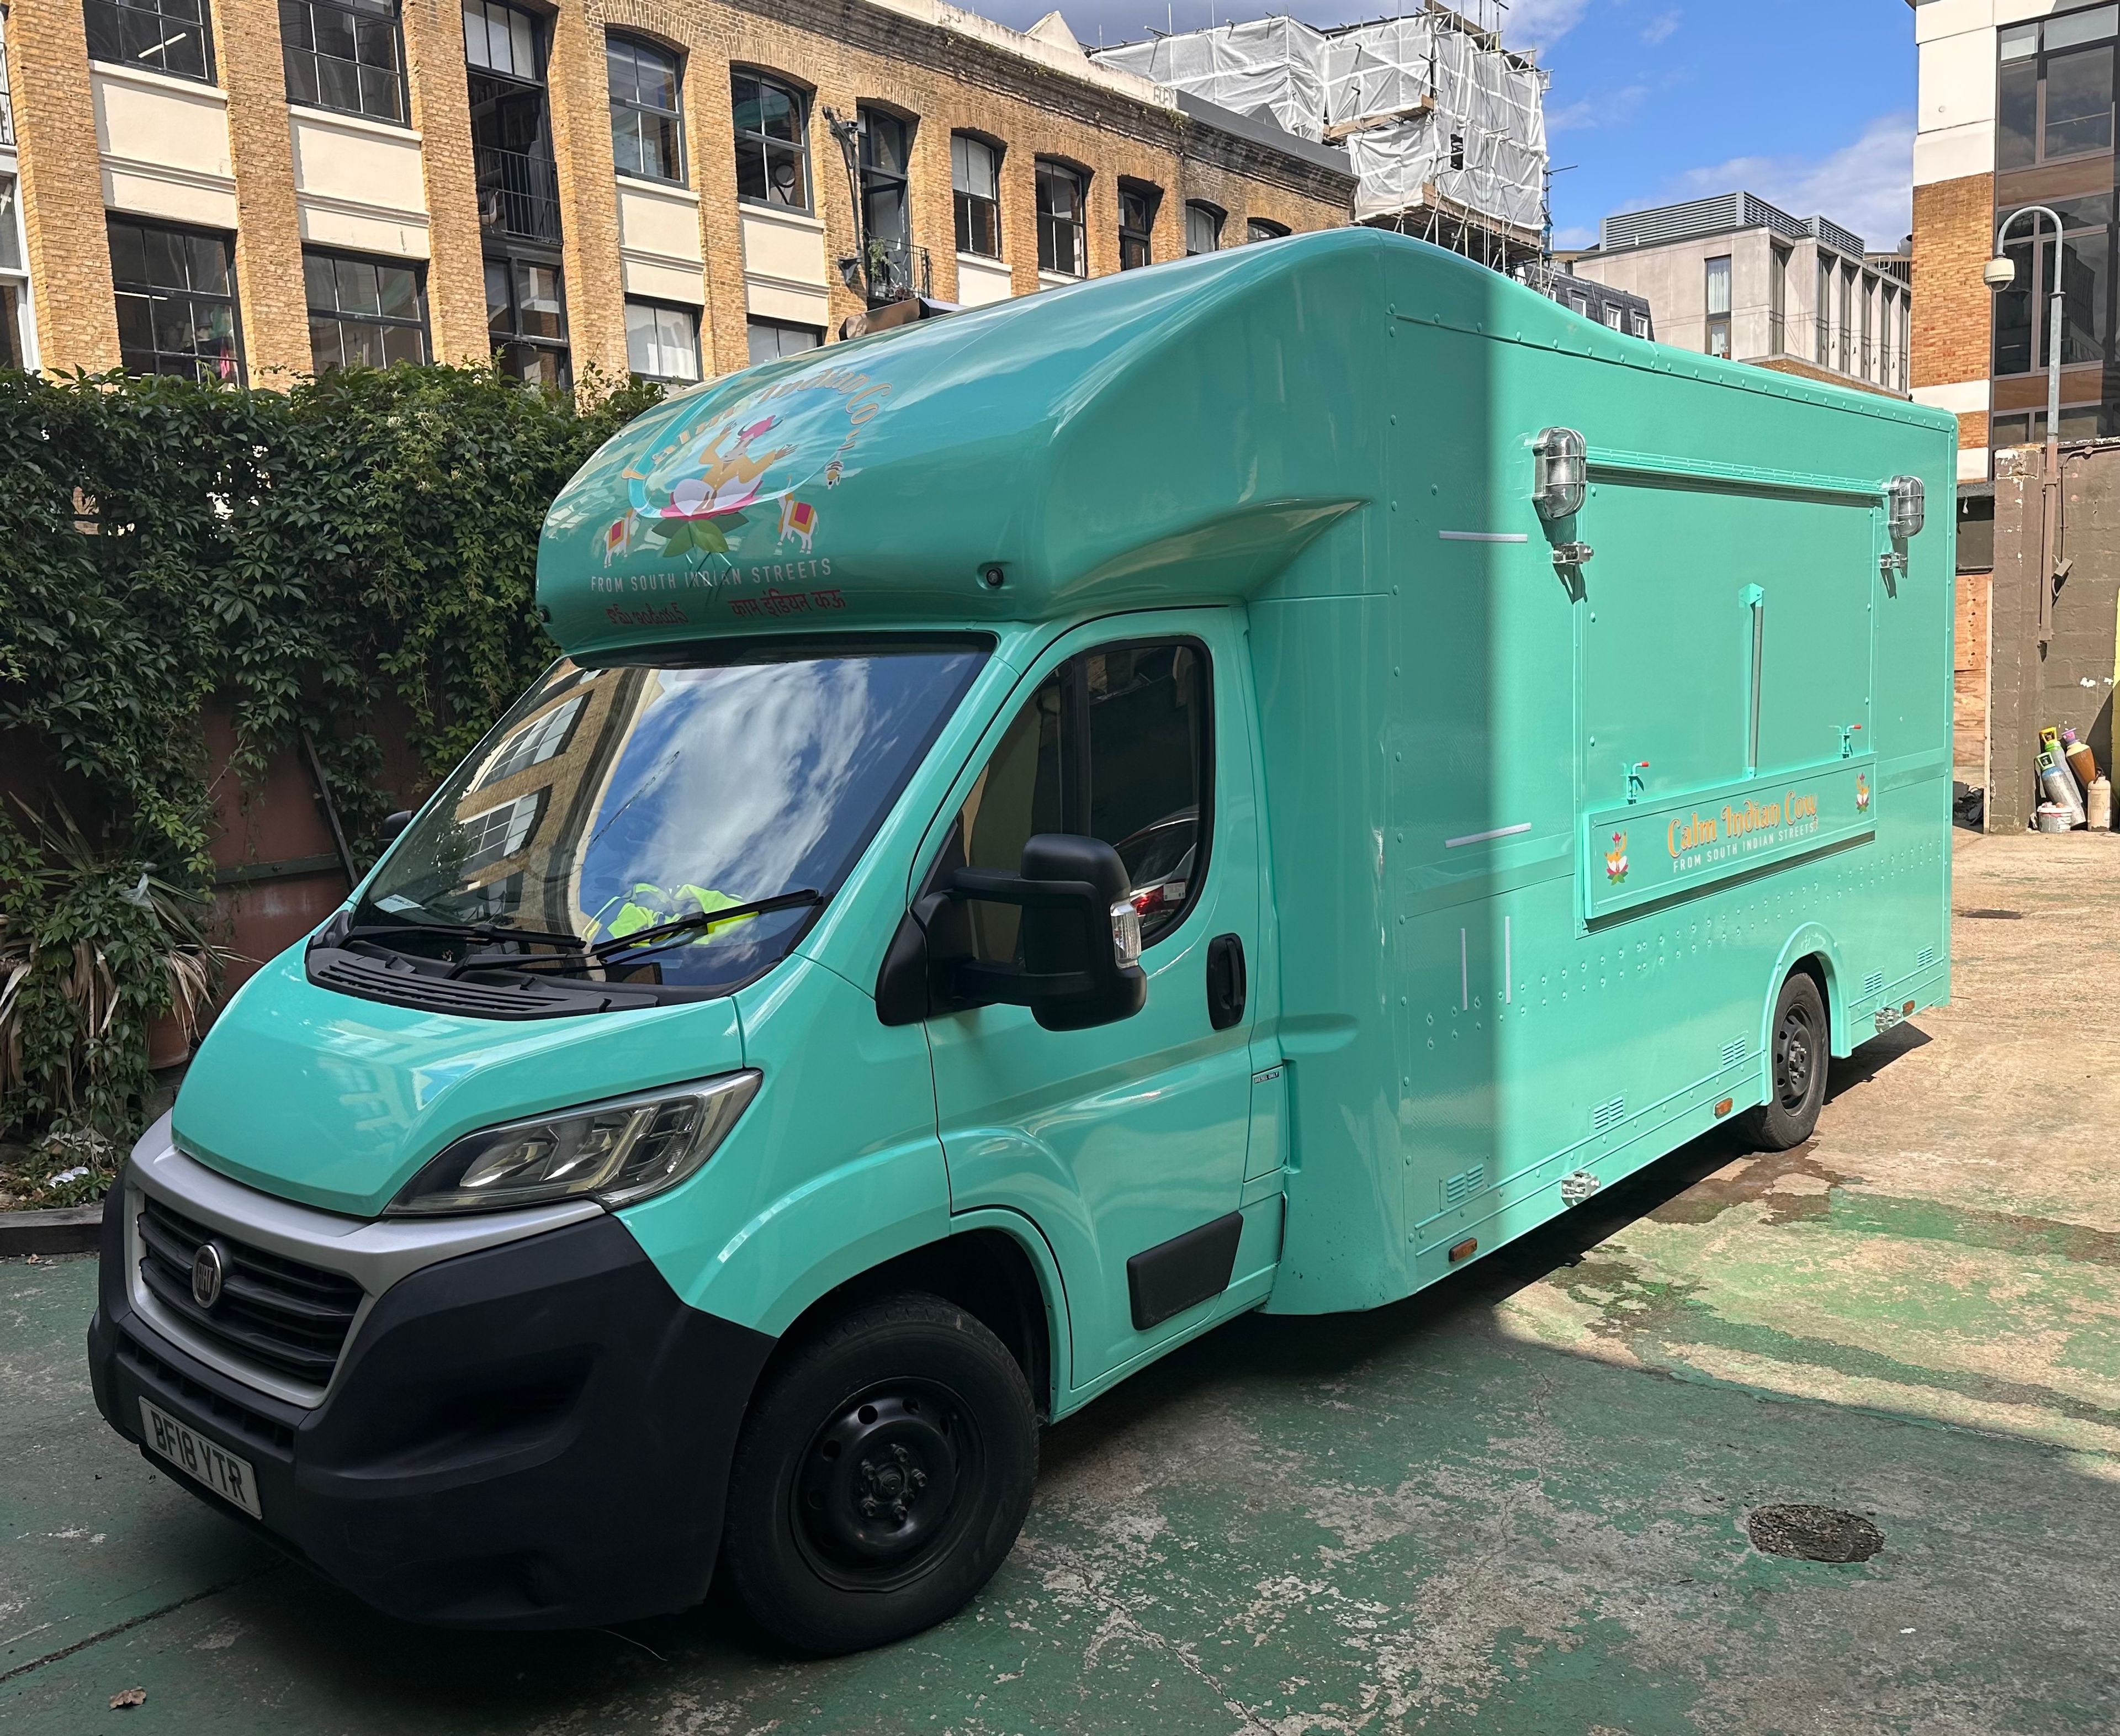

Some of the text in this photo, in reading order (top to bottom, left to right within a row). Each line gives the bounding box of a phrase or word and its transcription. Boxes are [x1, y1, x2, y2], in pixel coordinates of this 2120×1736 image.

[591, 558, 831, 593] FROM SOUTH INDIAN STREETS
[728, 588, 846, 617] काम इंडियन कऊ
[1668, 790, 1818, 859] Calm Indian Cow
[1673, 822, 1815, 874] FROM SOUTH INDIAN STREETS
[197, 1262, 214, 1293] FIAT
[151, 1409, 247, 1504] BF18 YTR
